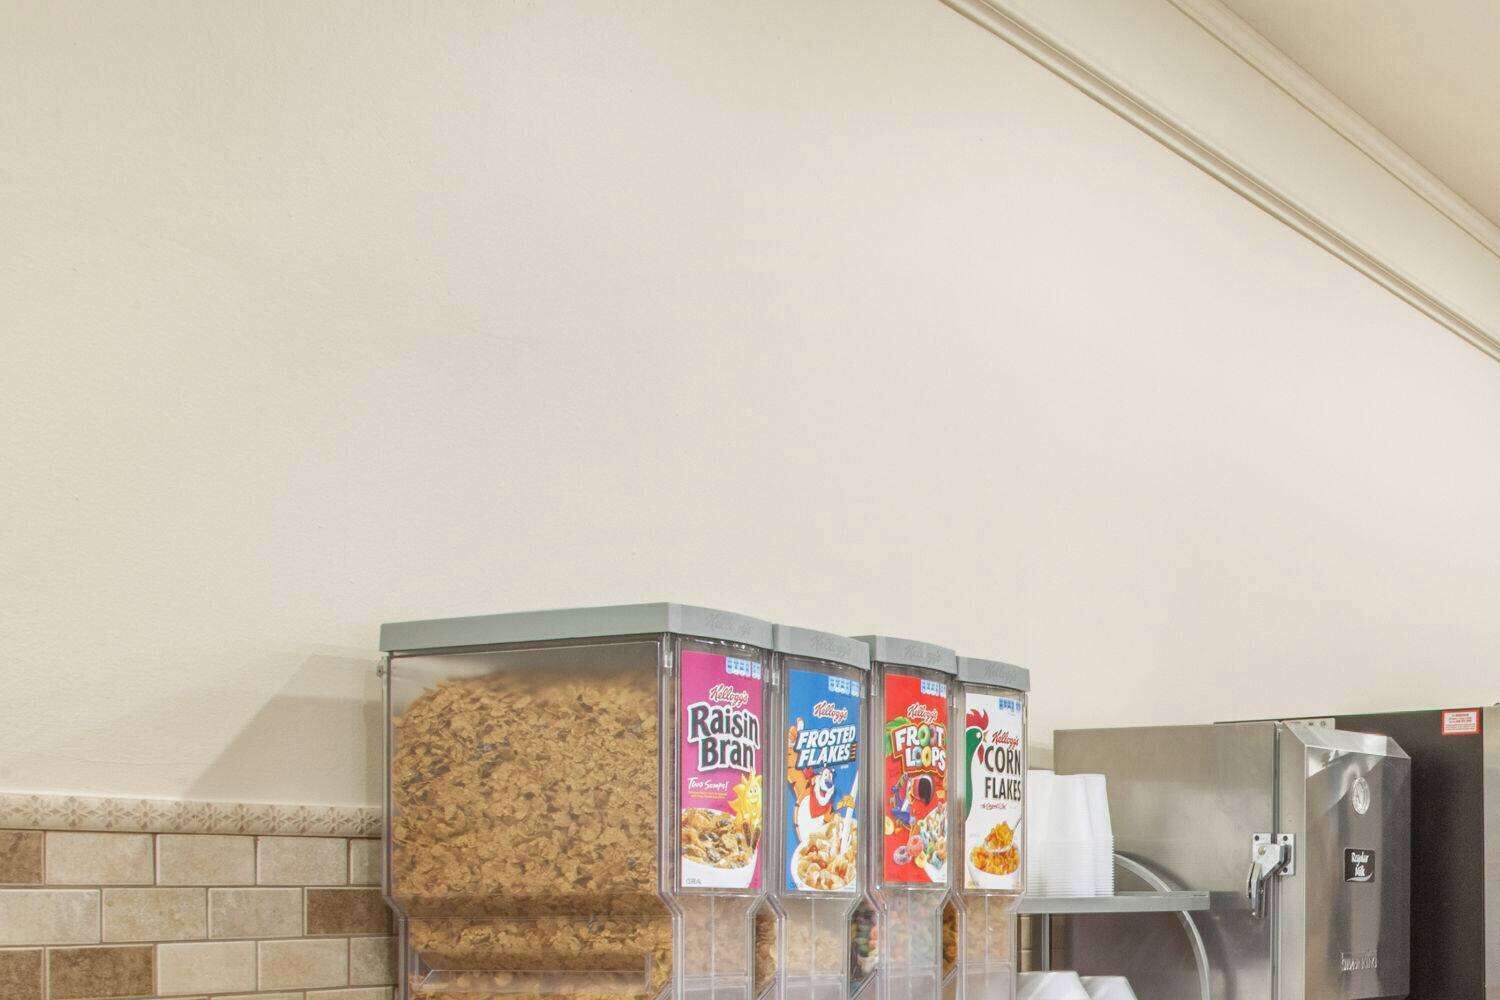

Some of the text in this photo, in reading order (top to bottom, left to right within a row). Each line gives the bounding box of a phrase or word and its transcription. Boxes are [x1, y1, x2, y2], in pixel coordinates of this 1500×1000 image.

[709, 684, 749, 708] Kellogg's
[687, 701, 760, 749] Raisin
[813, 700, 848, 724] Kellogg's
[907, 703, 938, 726] Kellogg's
[796, 725, 856, 750] FROSTED
[895, 724, 944, 752] FROOT
[698, 737, 755, 772] Bran
[798, 743, 851, 768] FLAKES
[905, 746, 946, 772] LOOPS
[984, 745, 1021, 776] CORN
[984, 776, 1021, 802] FLAKES
